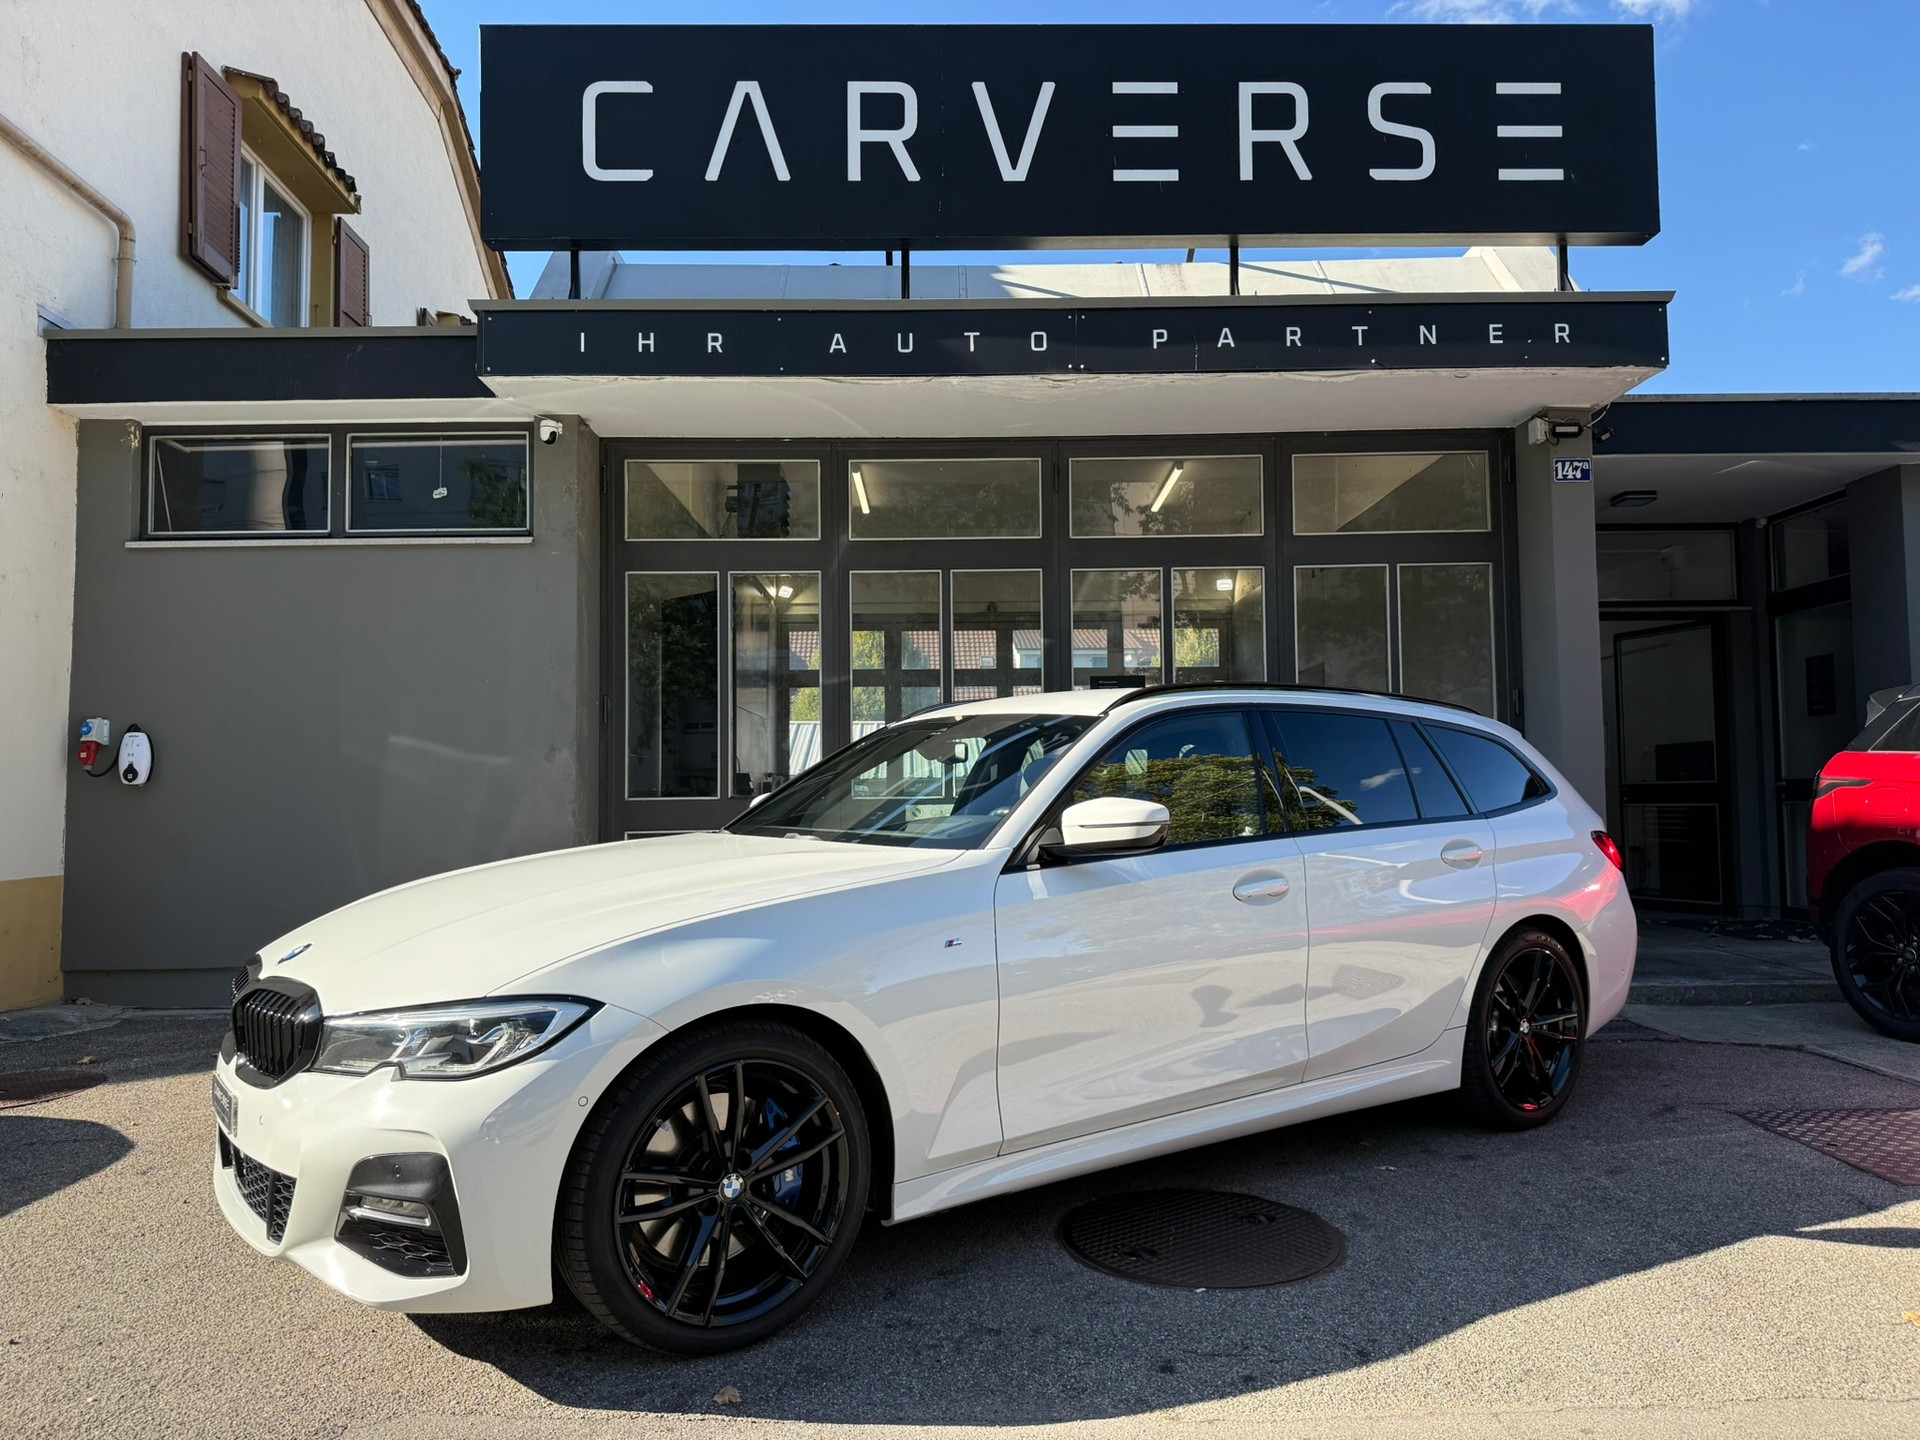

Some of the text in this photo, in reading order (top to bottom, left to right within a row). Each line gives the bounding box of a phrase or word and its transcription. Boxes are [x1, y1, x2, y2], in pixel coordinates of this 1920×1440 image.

[582, 80, 1564, 182] CARVERSE
[580, 323, 1571, 354] IHR AUTO PARTNER
[1555, 461, 1589, 479] 147a
